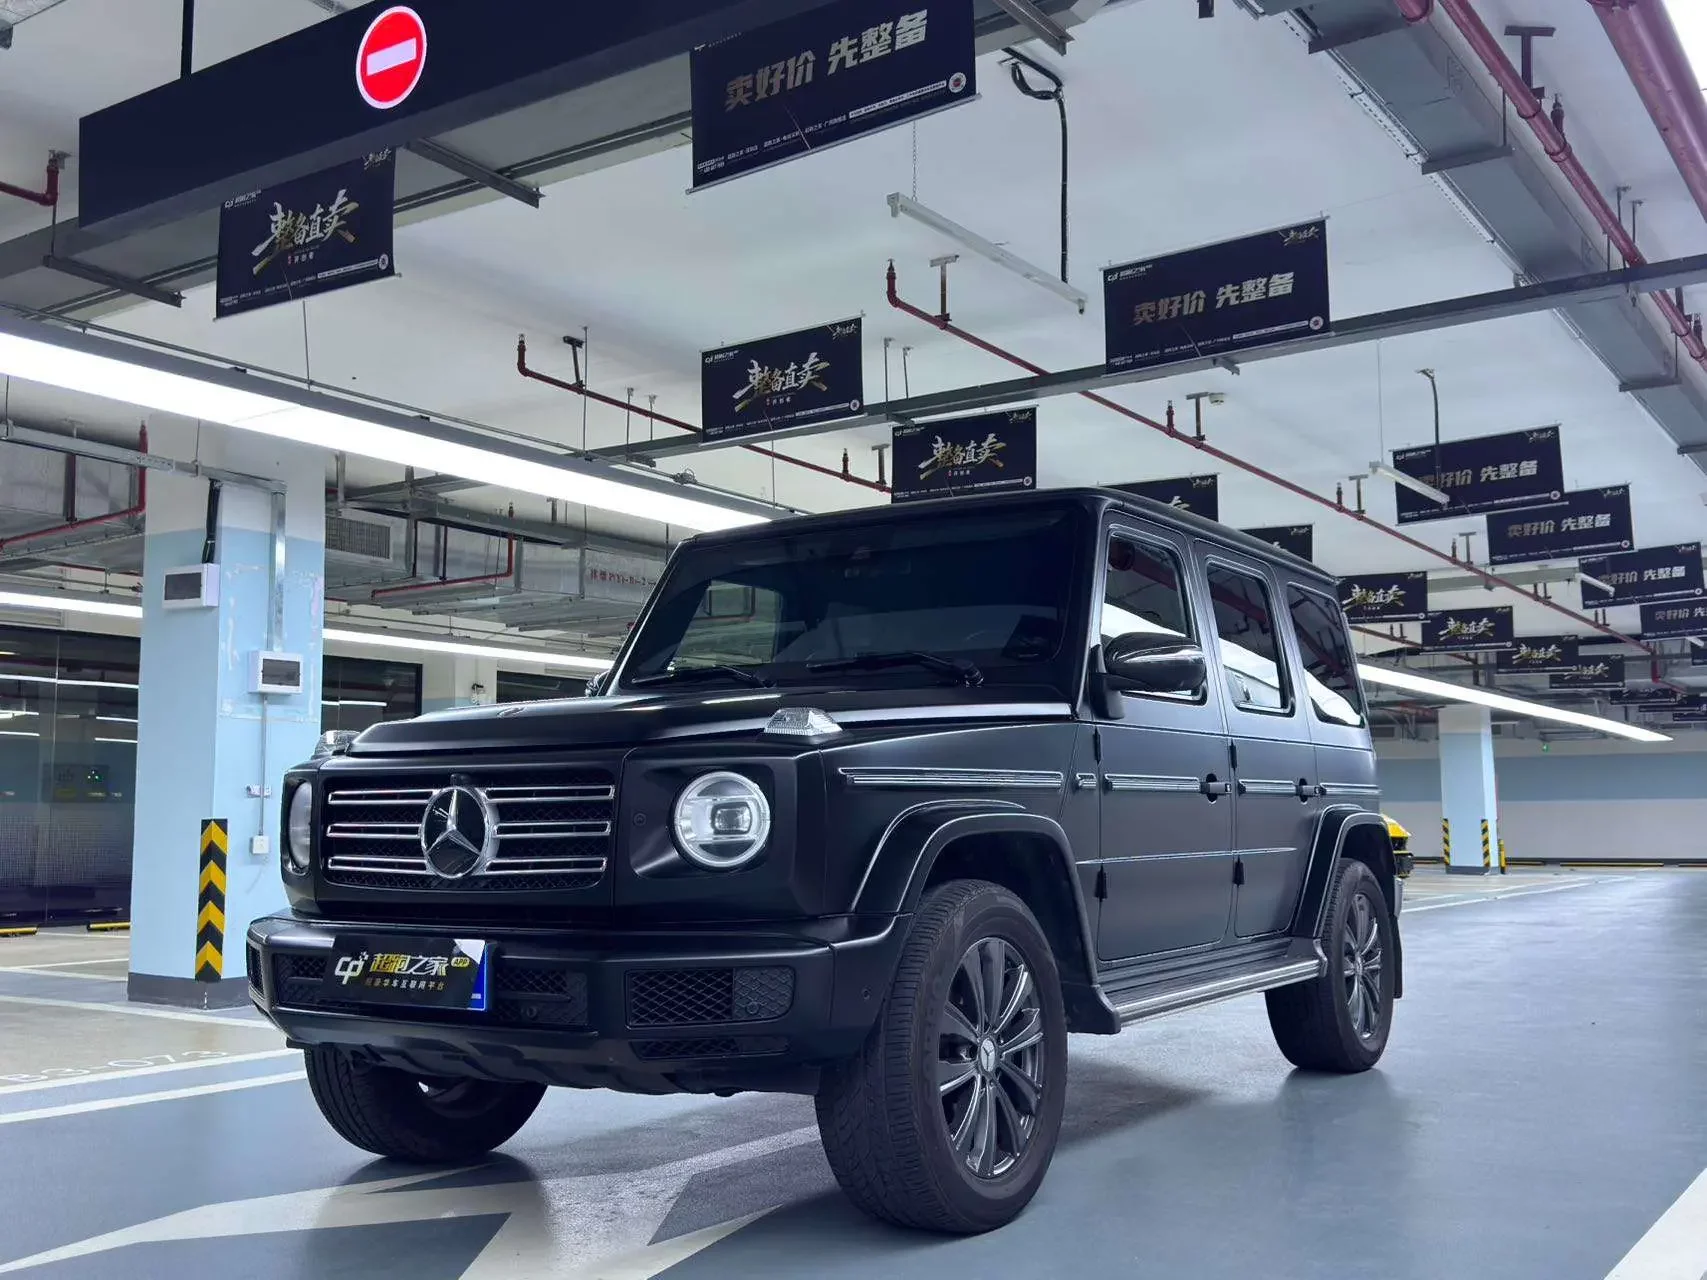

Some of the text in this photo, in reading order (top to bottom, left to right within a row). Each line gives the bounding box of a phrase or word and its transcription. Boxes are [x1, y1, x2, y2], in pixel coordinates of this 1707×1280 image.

[725, 50, 816, 112] 卖好价
[828, 9, 928, 76] 先整备
[1133, 272, 1295, 326] 卖好价 先整备
[1479, 459, 1539, 483] 先整备
